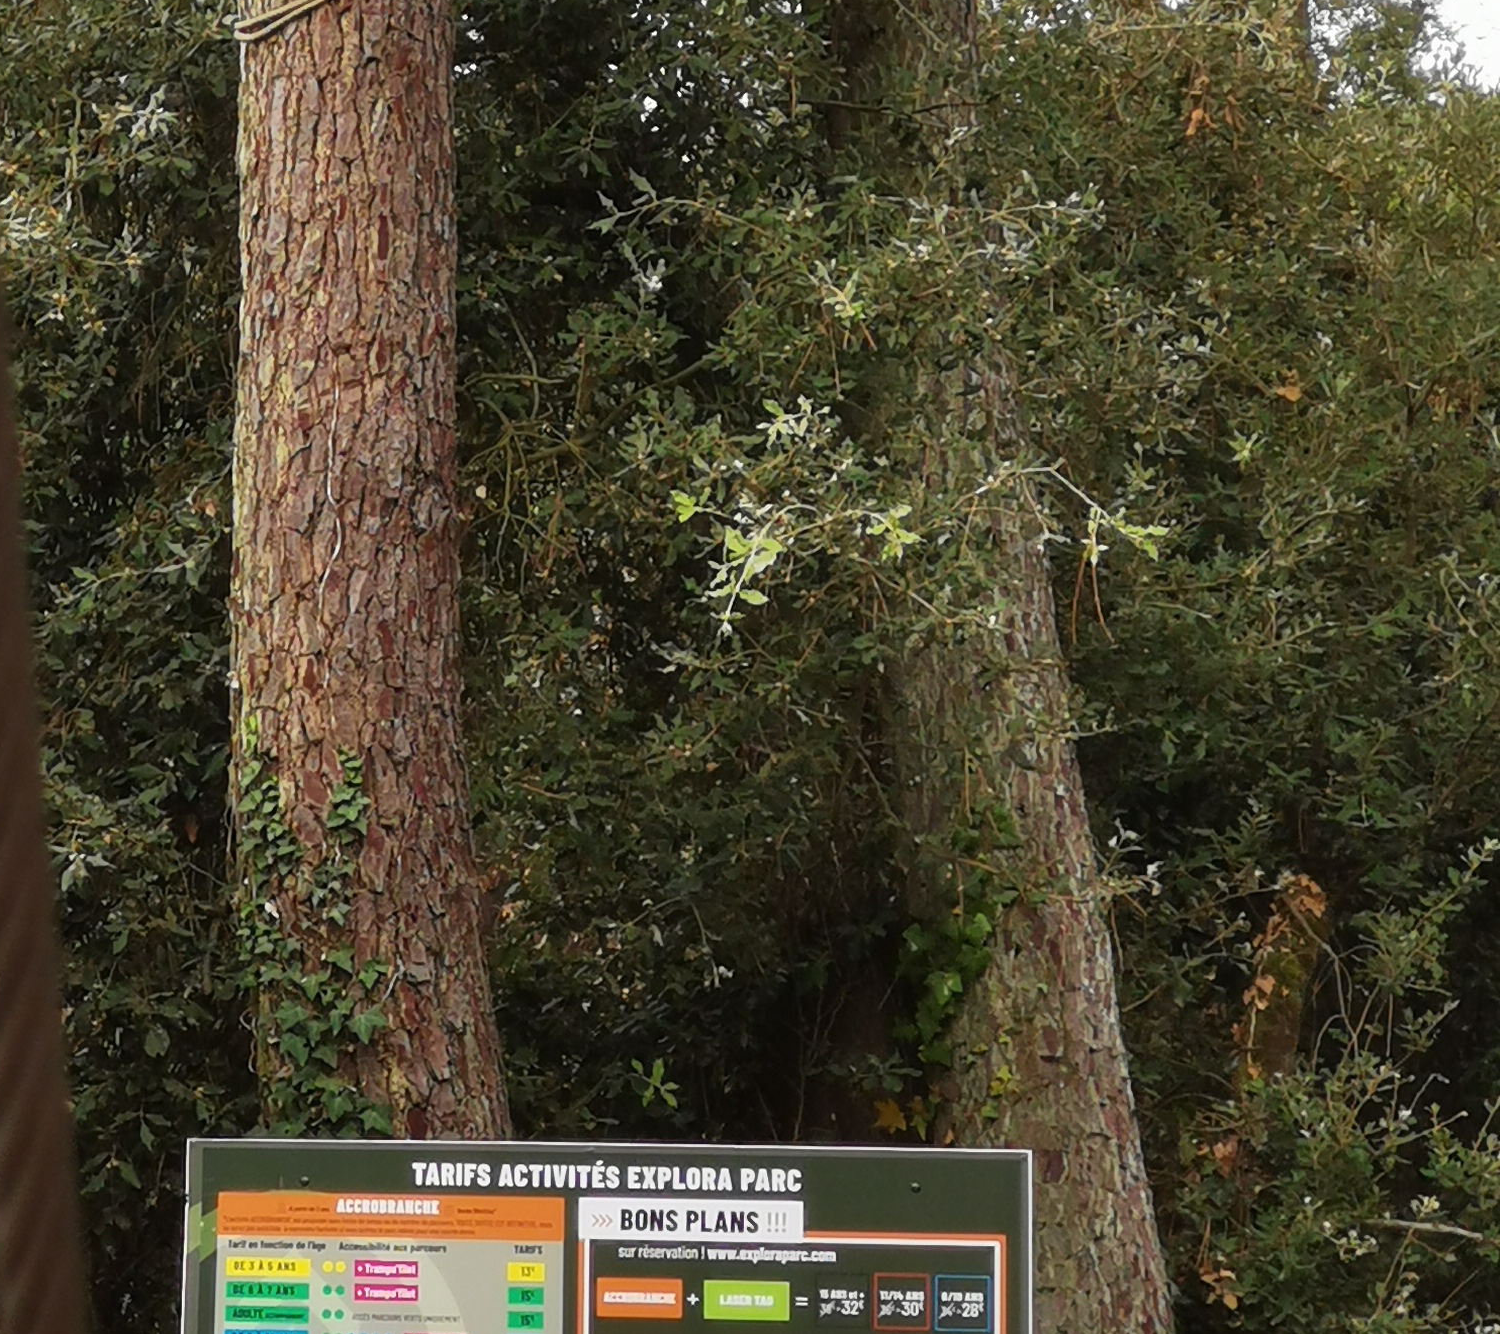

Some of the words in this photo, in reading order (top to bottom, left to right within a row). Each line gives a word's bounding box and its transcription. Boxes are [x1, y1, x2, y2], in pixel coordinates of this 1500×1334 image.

[413, 1162, 491, 1187] TARIFS
[498, 1161, 619, 1189] ACTIVITÉS
[628, 1166, 732, 1191] EXPLORA
[741, 1168, 802, 1192] PARC
[621, 1209, 677, 1231] BONS
[686, 1210, 759, 1233] PLANS
[767, 1215, 787, 1233] !!!
[619, 1248, 634, 1258] sur
[638, 1245, 698, 1260] réservation
